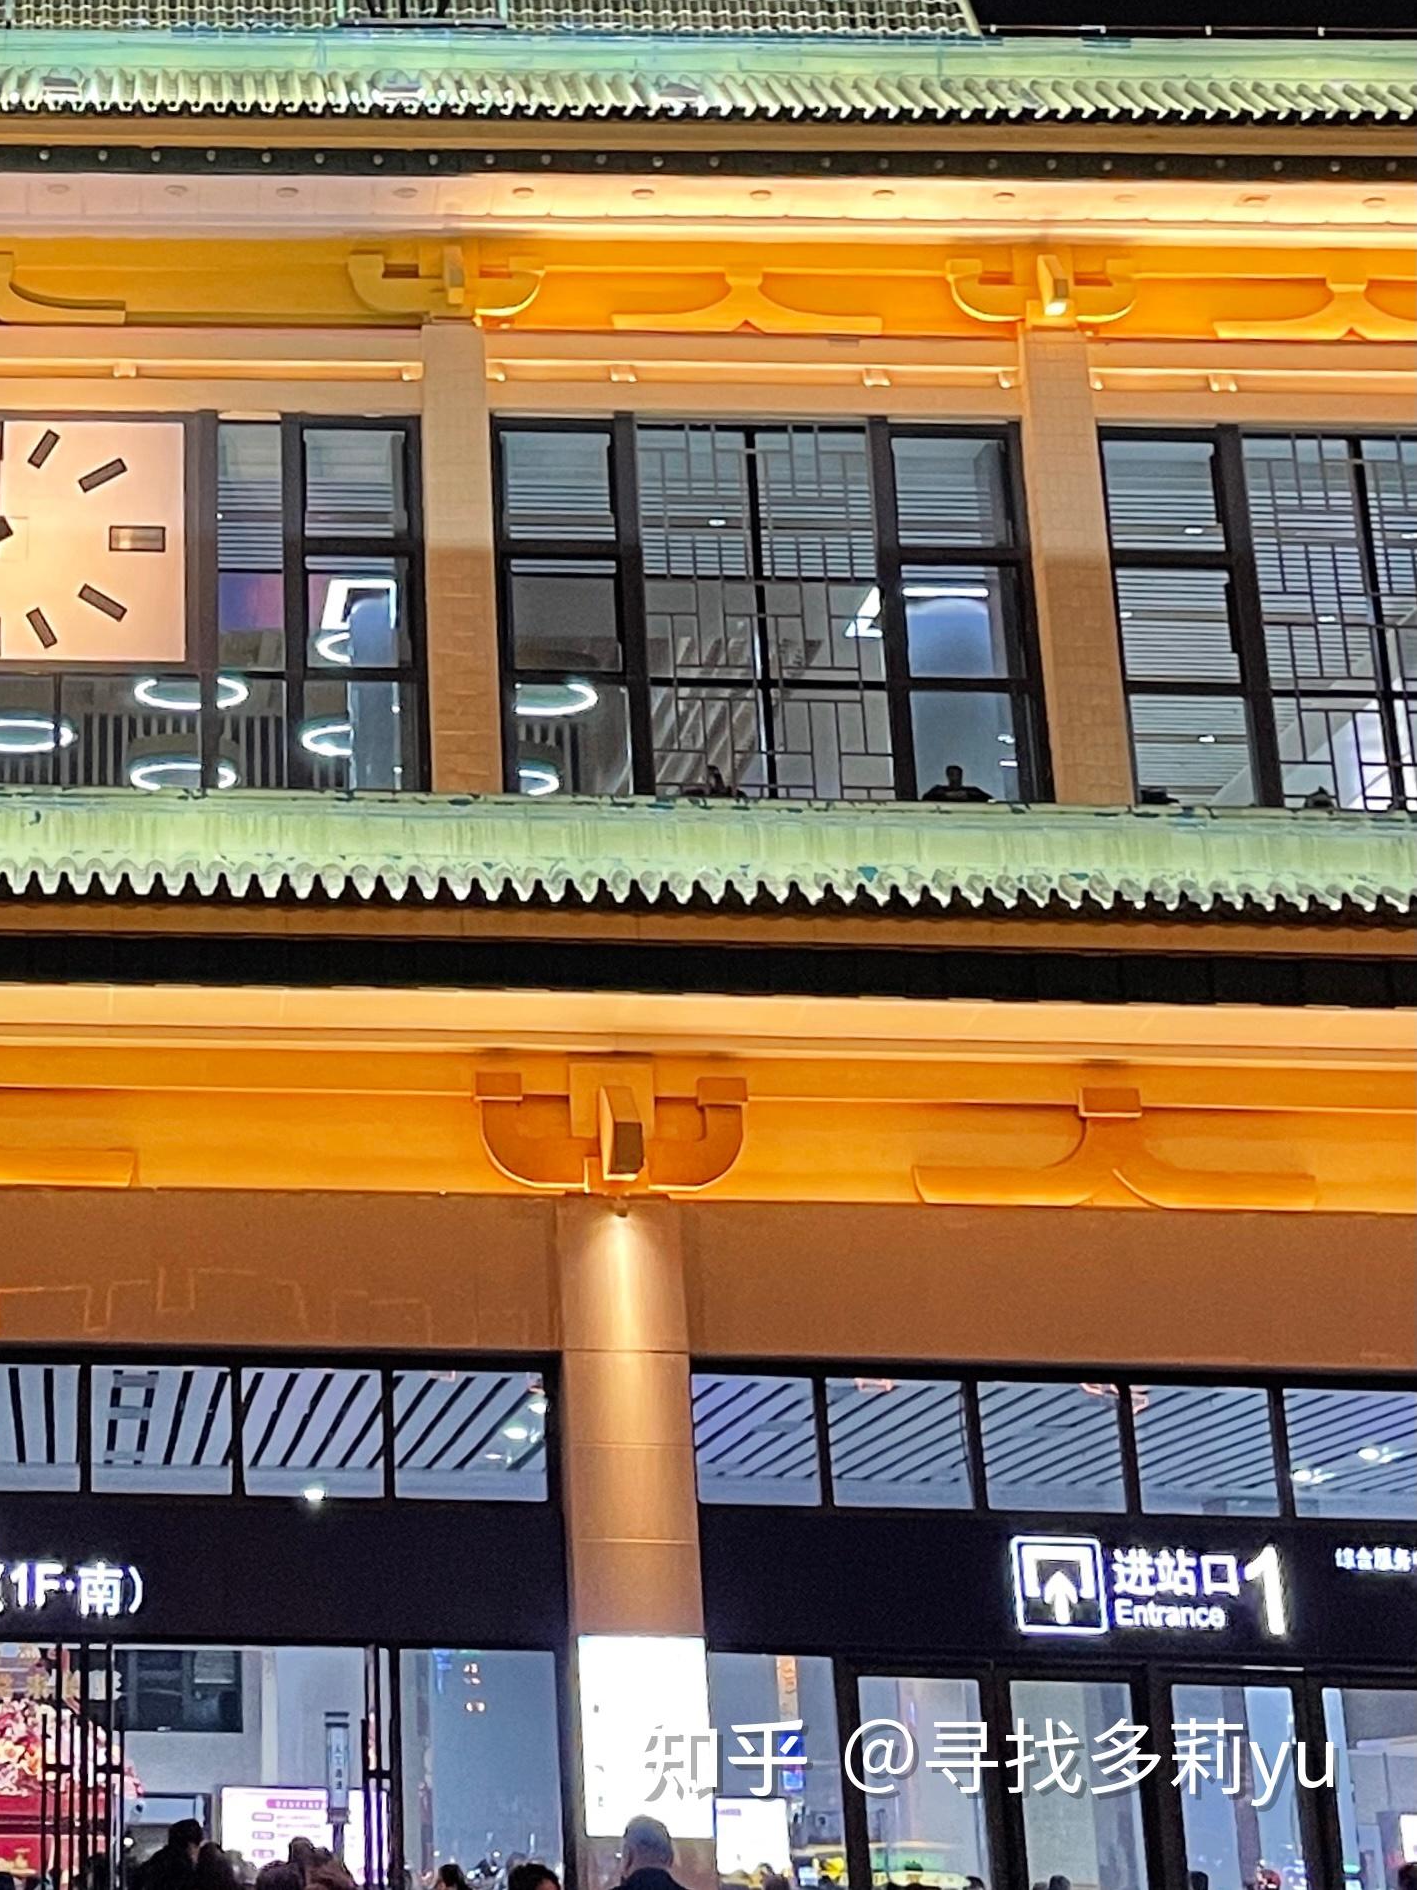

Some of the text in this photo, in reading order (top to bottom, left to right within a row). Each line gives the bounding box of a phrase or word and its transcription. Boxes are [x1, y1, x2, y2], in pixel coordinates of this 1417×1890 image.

[1335, 1546, 1417, 1572] 综合服务
[1112, 1544, 1288, 1636] 进站口 1
[1114, 1598, 1226, 1629] Entrance
